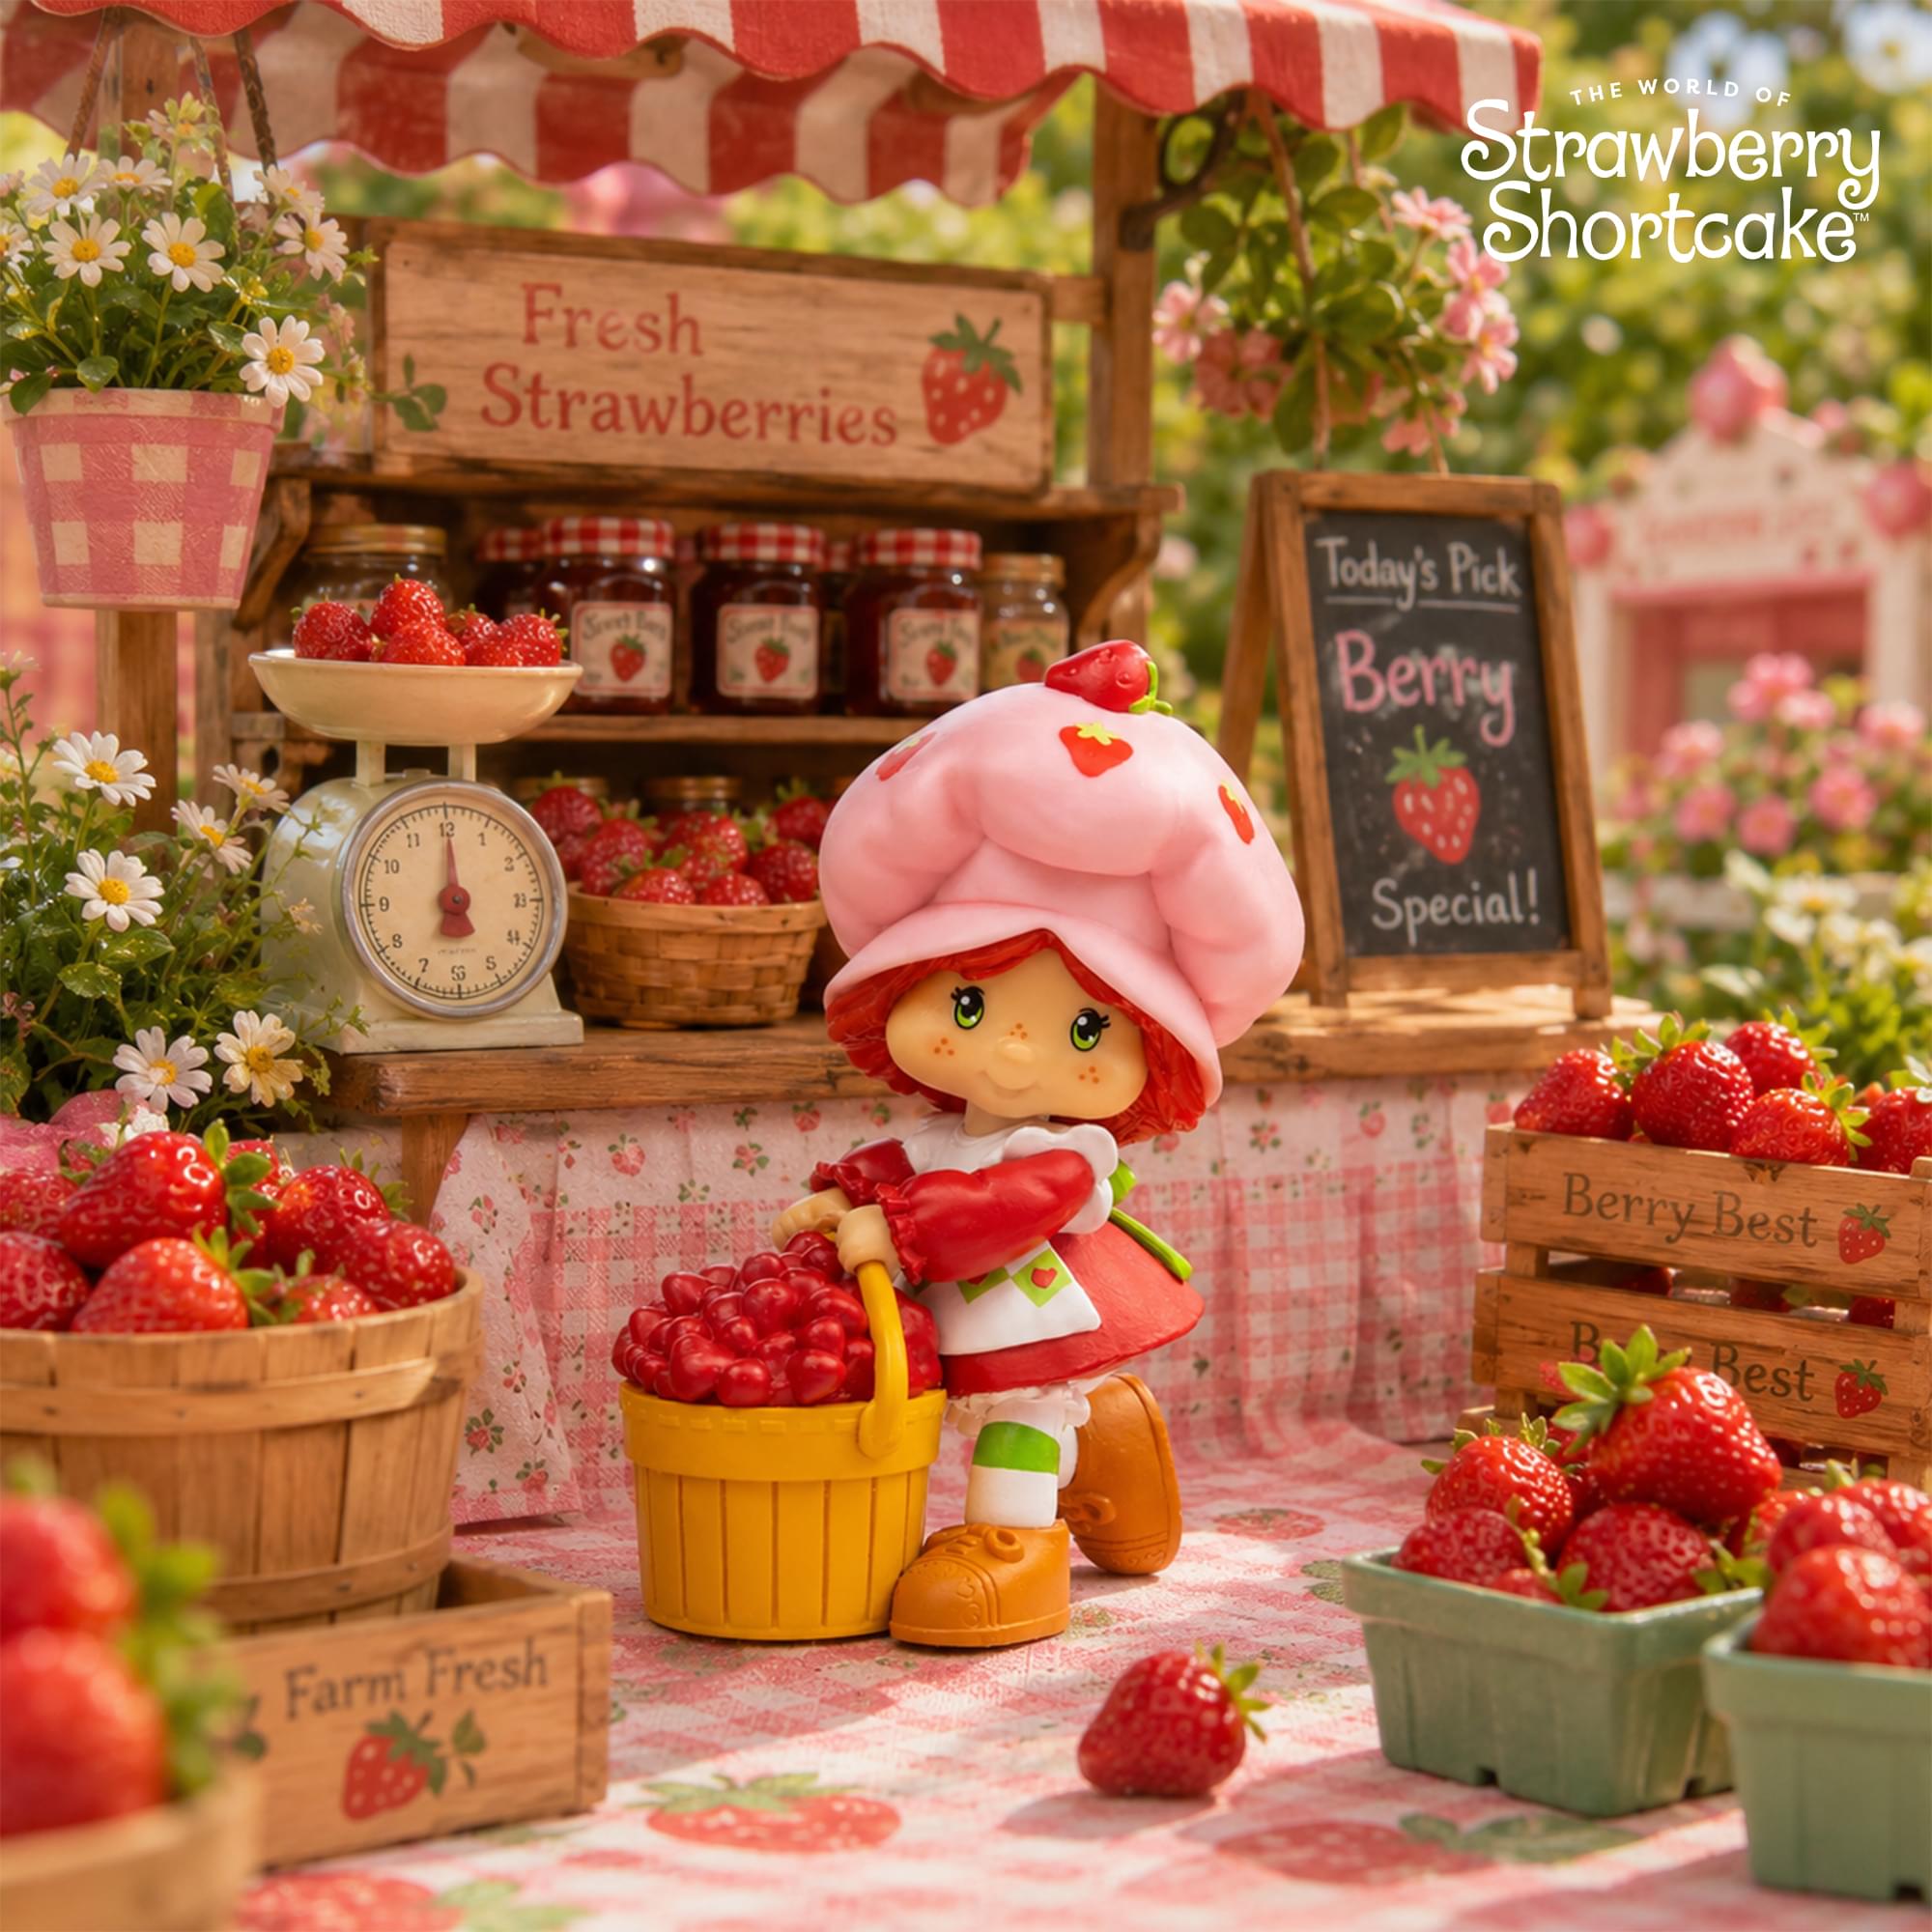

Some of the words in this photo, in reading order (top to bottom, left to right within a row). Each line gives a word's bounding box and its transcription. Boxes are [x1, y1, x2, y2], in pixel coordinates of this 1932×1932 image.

[522, 282, 703, 356] Fresh
[480, 362, 896, 447] Strawberries
[1315, 535, 1439, 612] Today's
[1447, 541, 1522, 598] Pick
[1335, 629, 1516, 747] Berry
[384, 859, 400, 874] 10
[407, 833, 420, 848] 11
[477, 832, 487, 847] 1
[1371, 867, 1541, 948] Special!
[1562, 1172, 1695, 1244] Berry
[1713, 1190, 1818, 1248] Best
[1710, 1342, 1815, 1402] Best
[284, 1663, 406, 1721] Farm
[424, 1636, 549, 1698] Fresh
